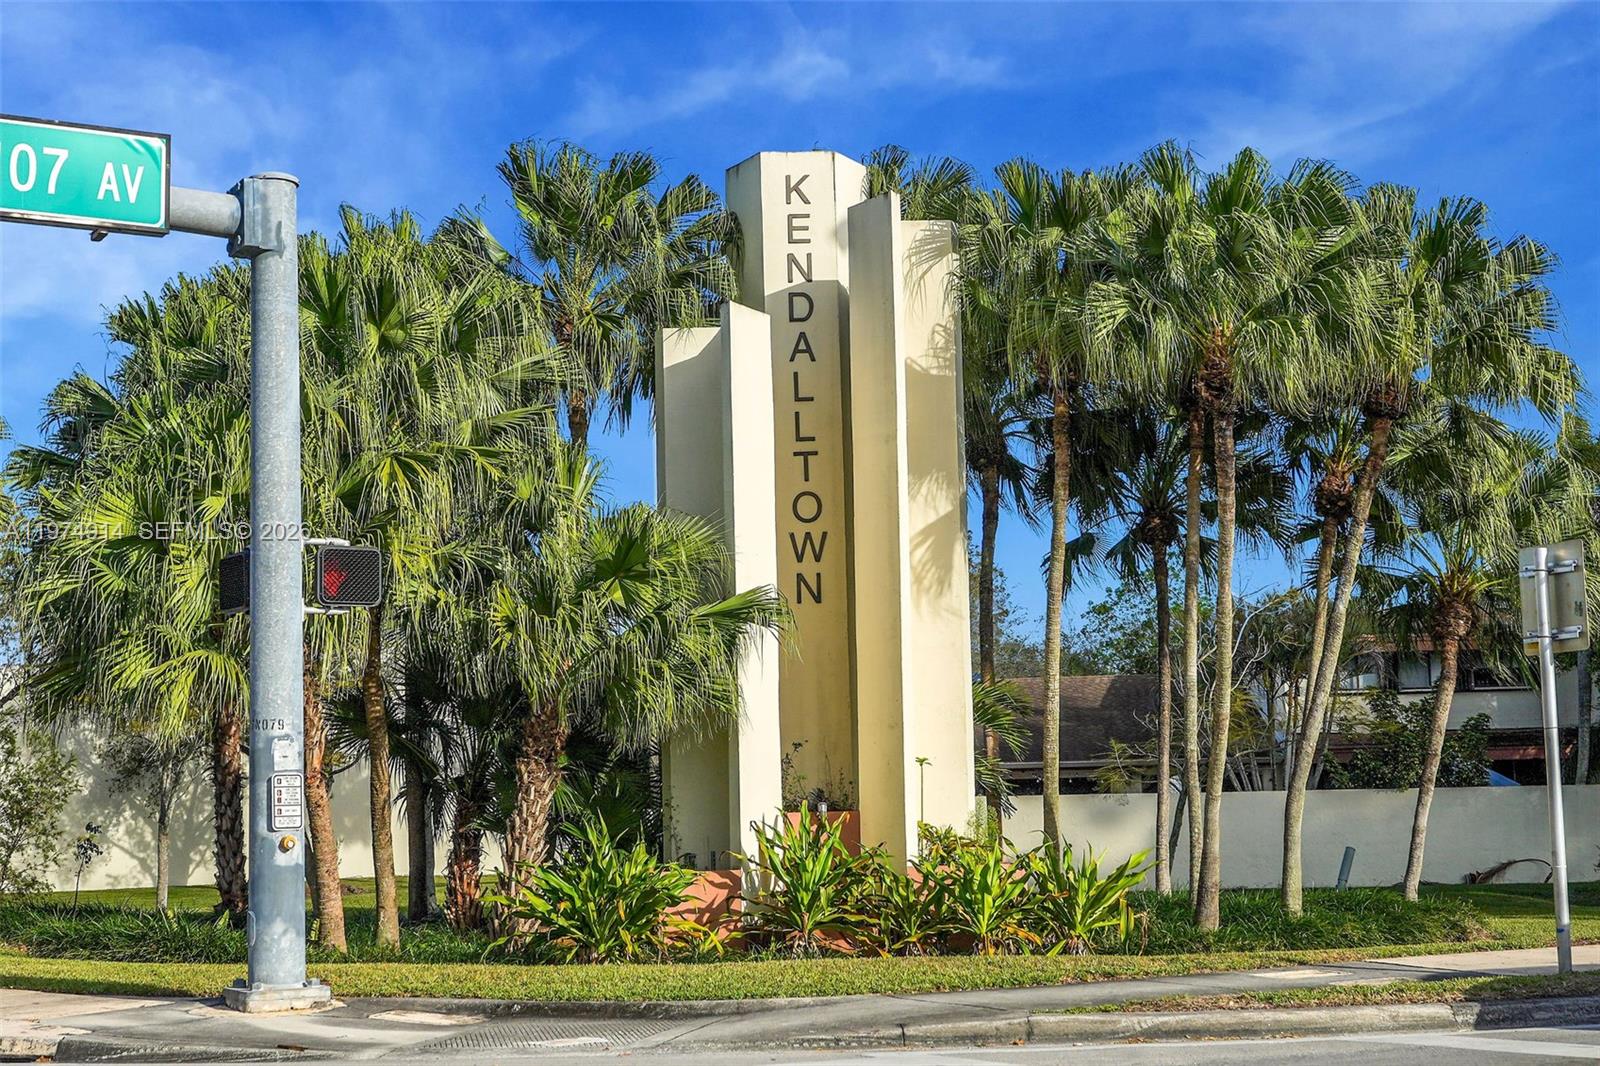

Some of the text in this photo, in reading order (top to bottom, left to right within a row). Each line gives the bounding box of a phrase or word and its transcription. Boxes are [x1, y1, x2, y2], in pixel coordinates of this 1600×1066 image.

[0, 141, 145, 204] 07 AV
[784, 174, 828, 604] KENDALLTOWN
